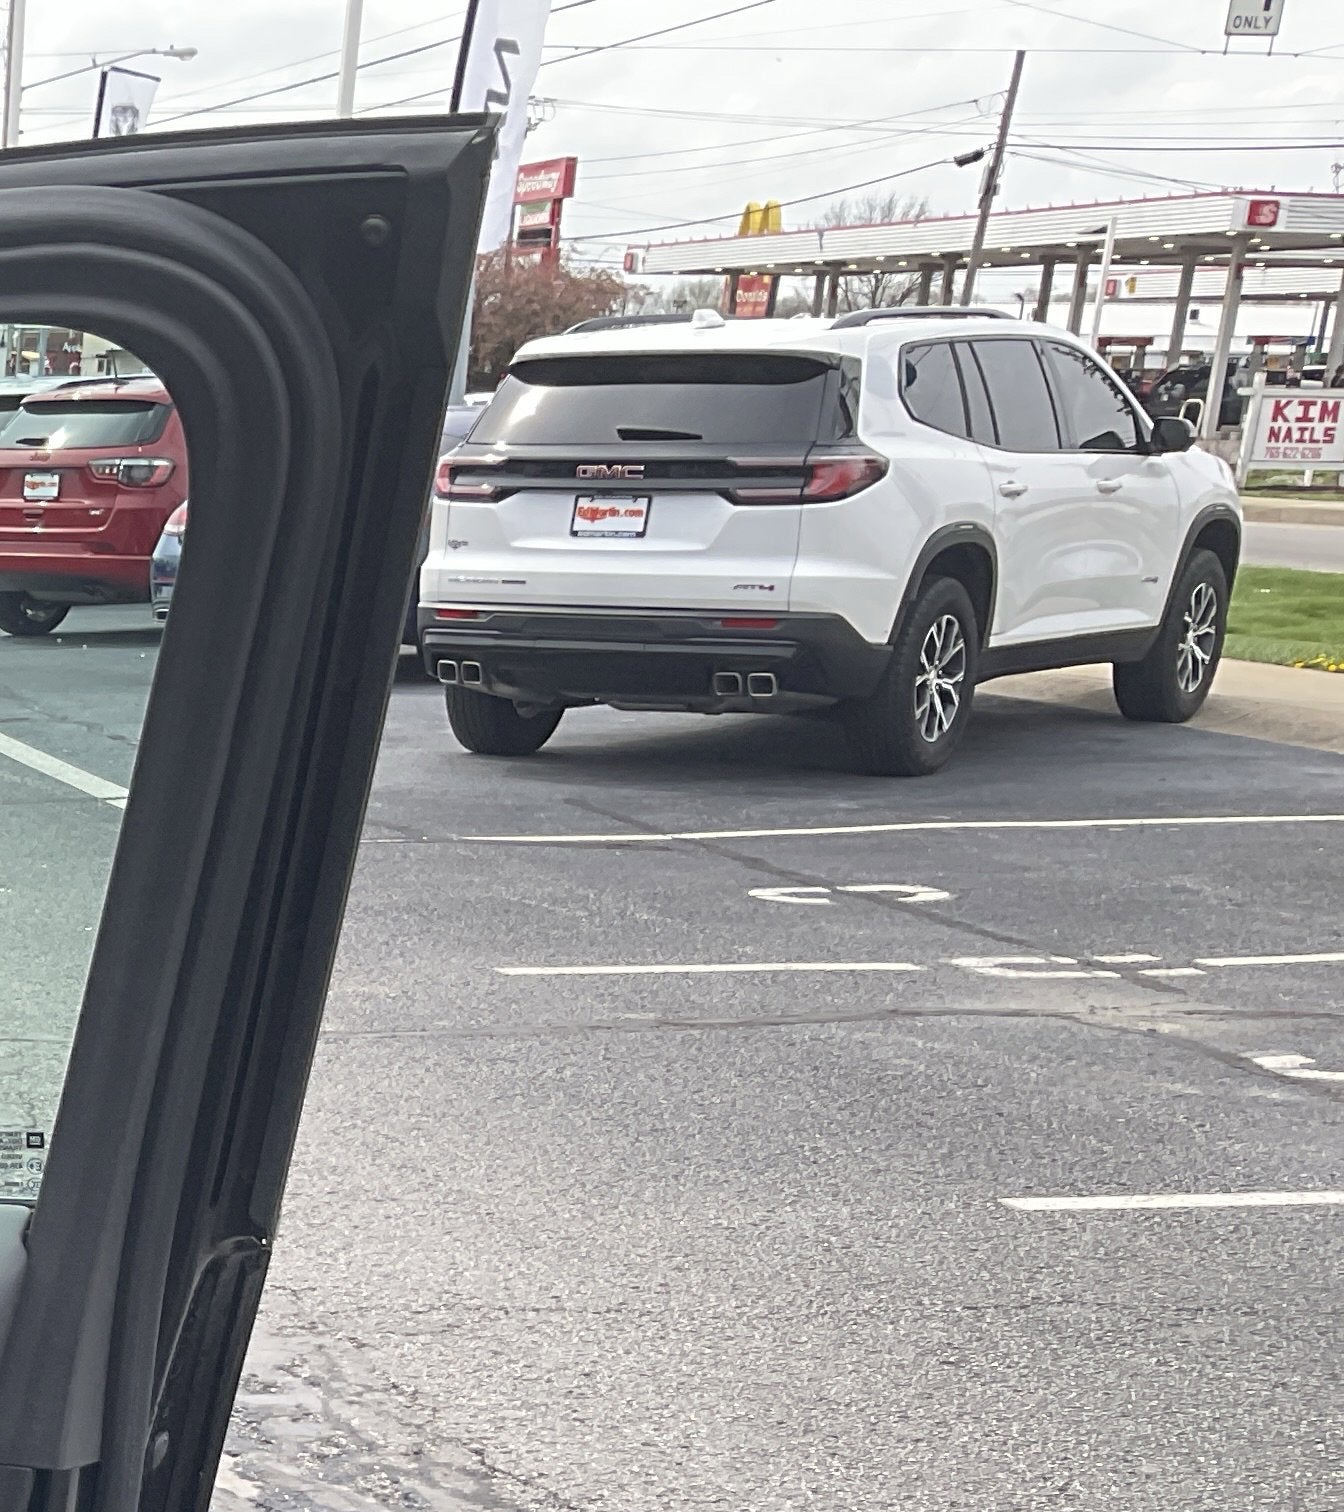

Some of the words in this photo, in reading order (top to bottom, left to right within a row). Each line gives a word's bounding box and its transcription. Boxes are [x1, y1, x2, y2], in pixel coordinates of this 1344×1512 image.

[1233, 15, 1273, 29] ONLY
[516, 169, 561, 198] Speedway
[1271, 399, 1341, 423] KIM
[1267, 426, 1337, 444] NAILS
[575, 464, 646, 480] GMC
